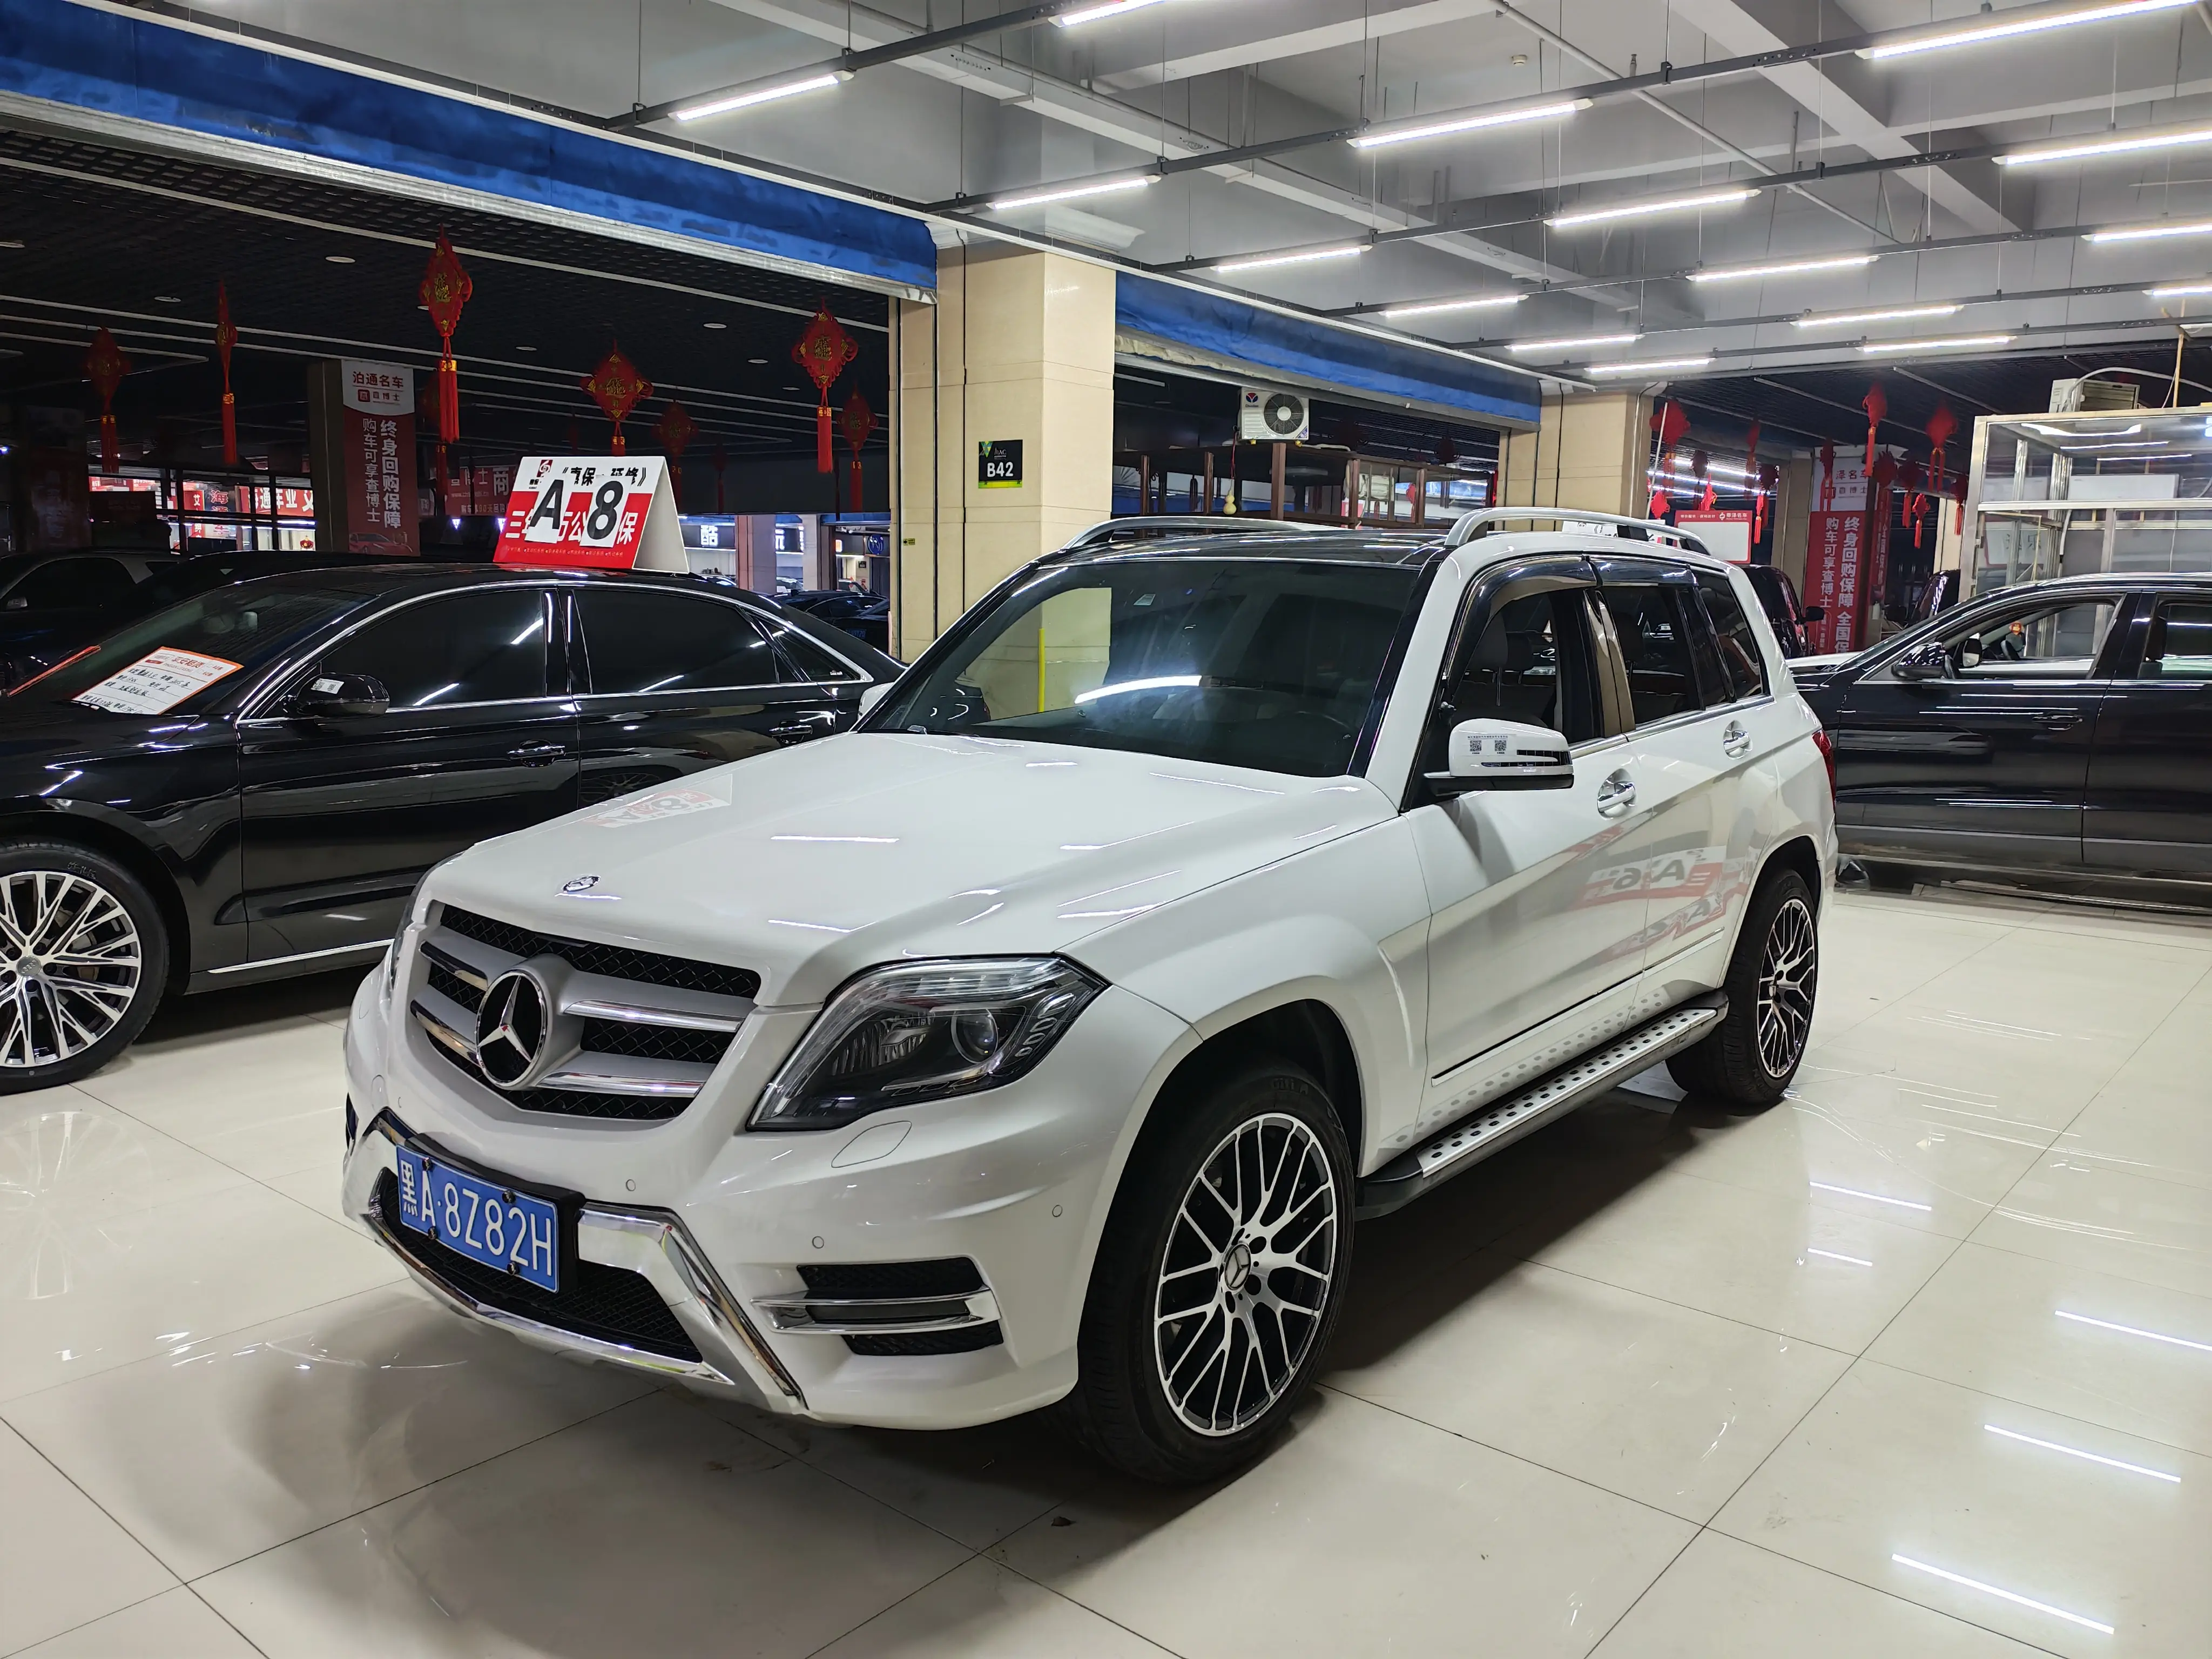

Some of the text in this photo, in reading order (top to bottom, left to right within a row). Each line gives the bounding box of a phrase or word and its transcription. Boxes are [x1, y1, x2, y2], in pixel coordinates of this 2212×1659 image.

[353, 371, 403, 388] 泊通名车
[363, 418, 380, 522] 购车可享查博士
[380, 420, 401, 529] 终身回购保障
[987, 462, 1014, 477] B42
[1819, 517, 1839, 608] 购车可享查博士
[1838, 517, 1860, 608] 终身回购保障
